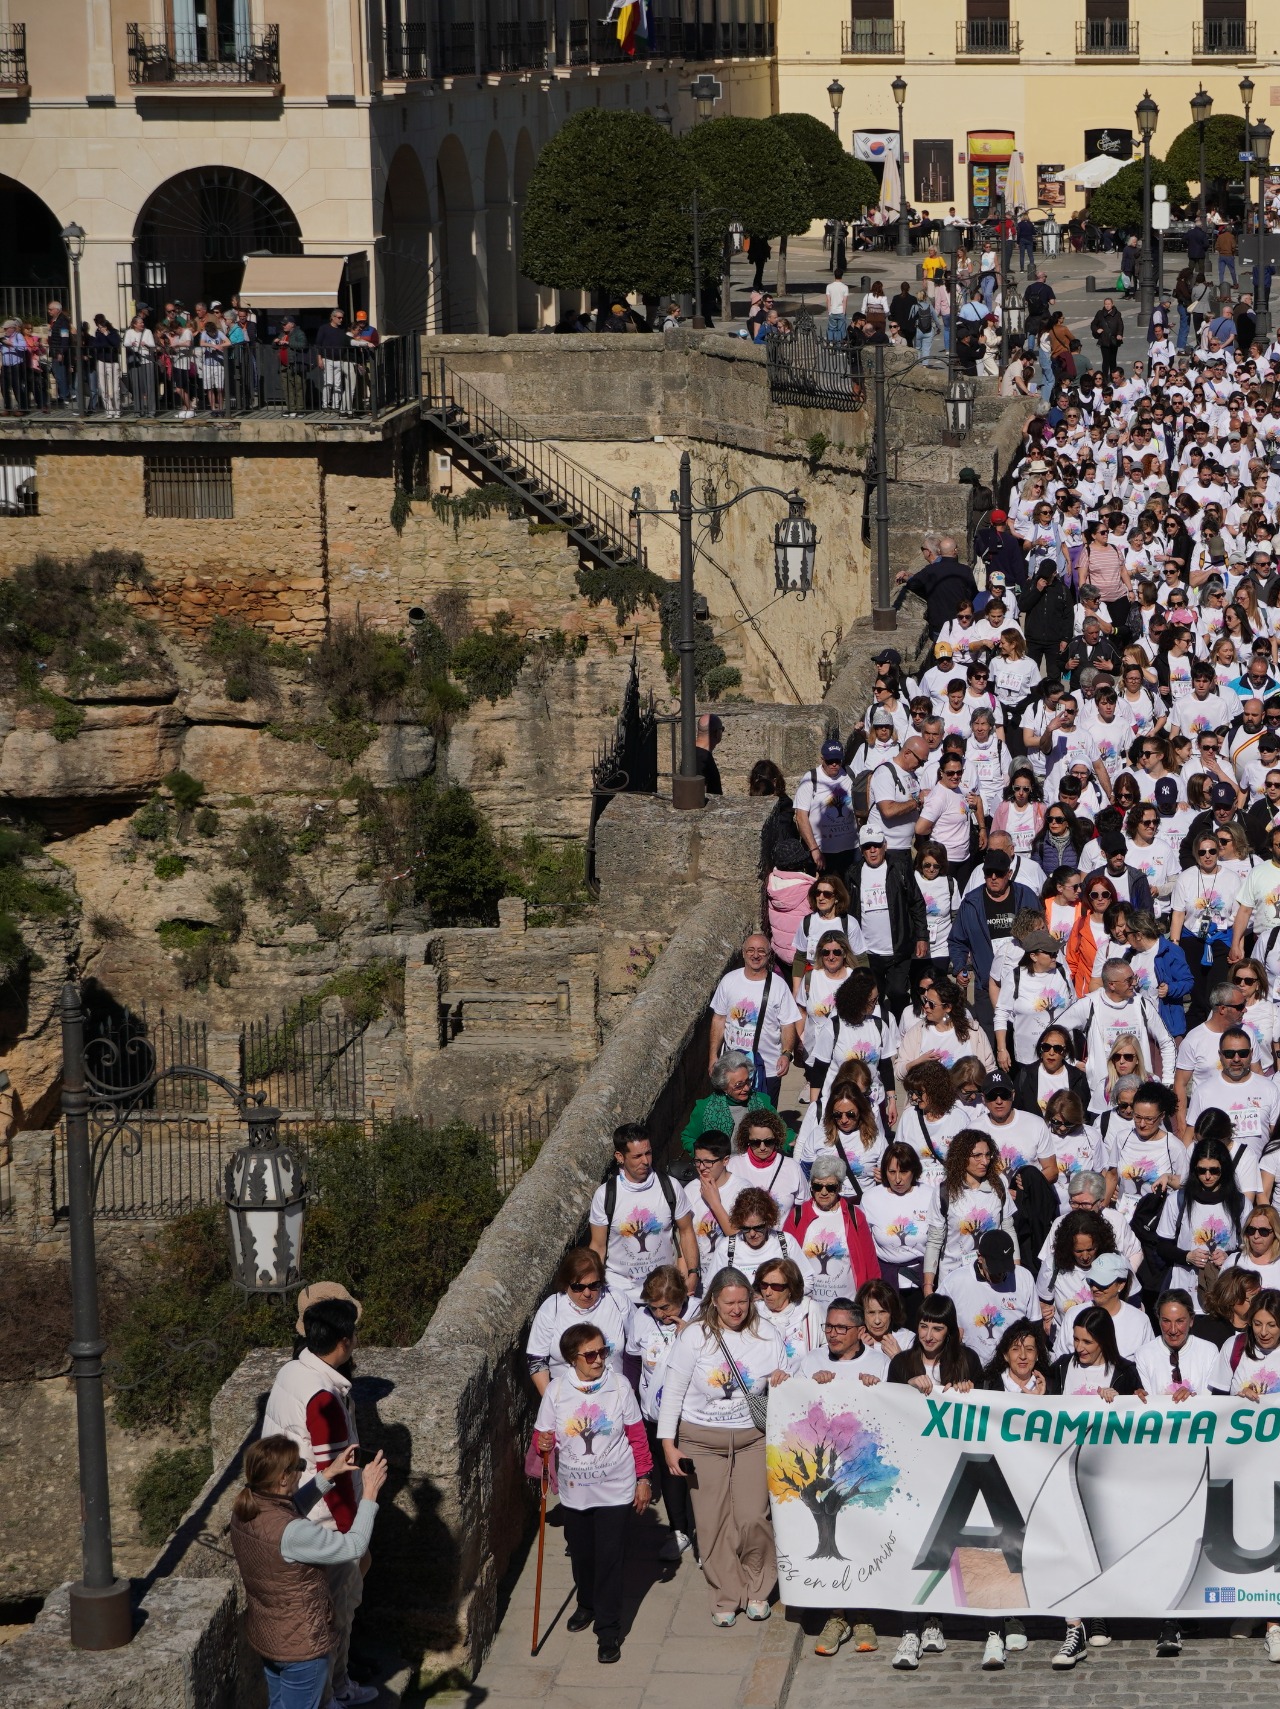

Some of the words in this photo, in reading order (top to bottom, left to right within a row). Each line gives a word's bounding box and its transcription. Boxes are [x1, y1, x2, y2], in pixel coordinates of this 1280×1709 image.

[921, 1399, 989, 1442] XIII
[1000, 1407, 1217, 1445] CAMINATA
[568, 1469, 608, 1480] AYUCA
[803, 1577, 827, 1588] en
[831, 1564, 853, 1592] el
[857, 1529, 897, 1583] camino
